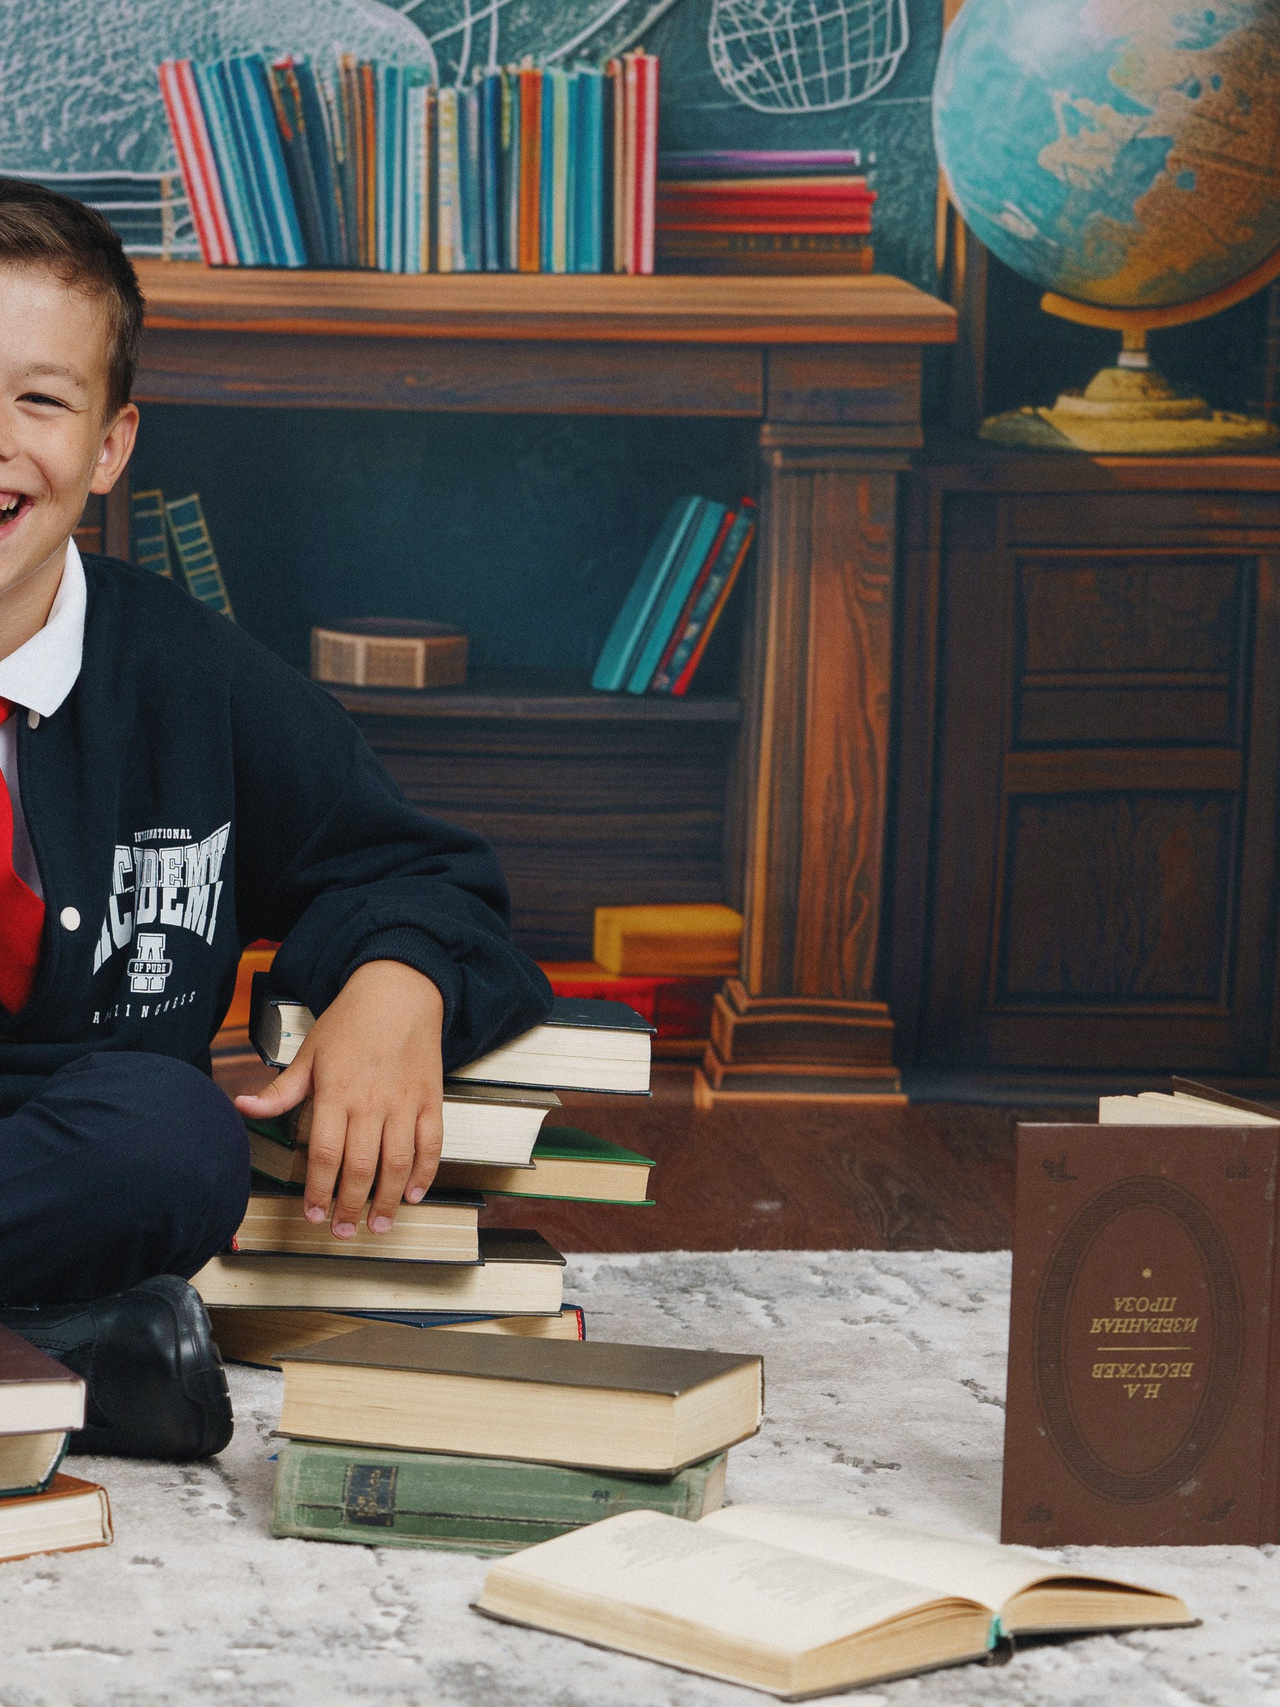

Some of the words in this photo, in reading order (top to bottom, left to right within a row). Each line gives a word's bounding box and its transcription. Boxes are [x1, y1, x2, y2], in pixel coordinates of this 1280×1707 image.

[93, 821, 231, 975] CDEMY
[134, 962, 144, 973] OF
[145, 962, 167, 973] PURE
[92, 991, 196, 1024] AZINGNESS
[1113, 1296, 1178, 1312] ПРОЗА
[1089, 1317, 1199, 1333] ИЗБРАННАЯ
[1091, 1362, 1195, 1378] БЕСТУЖЕВ
